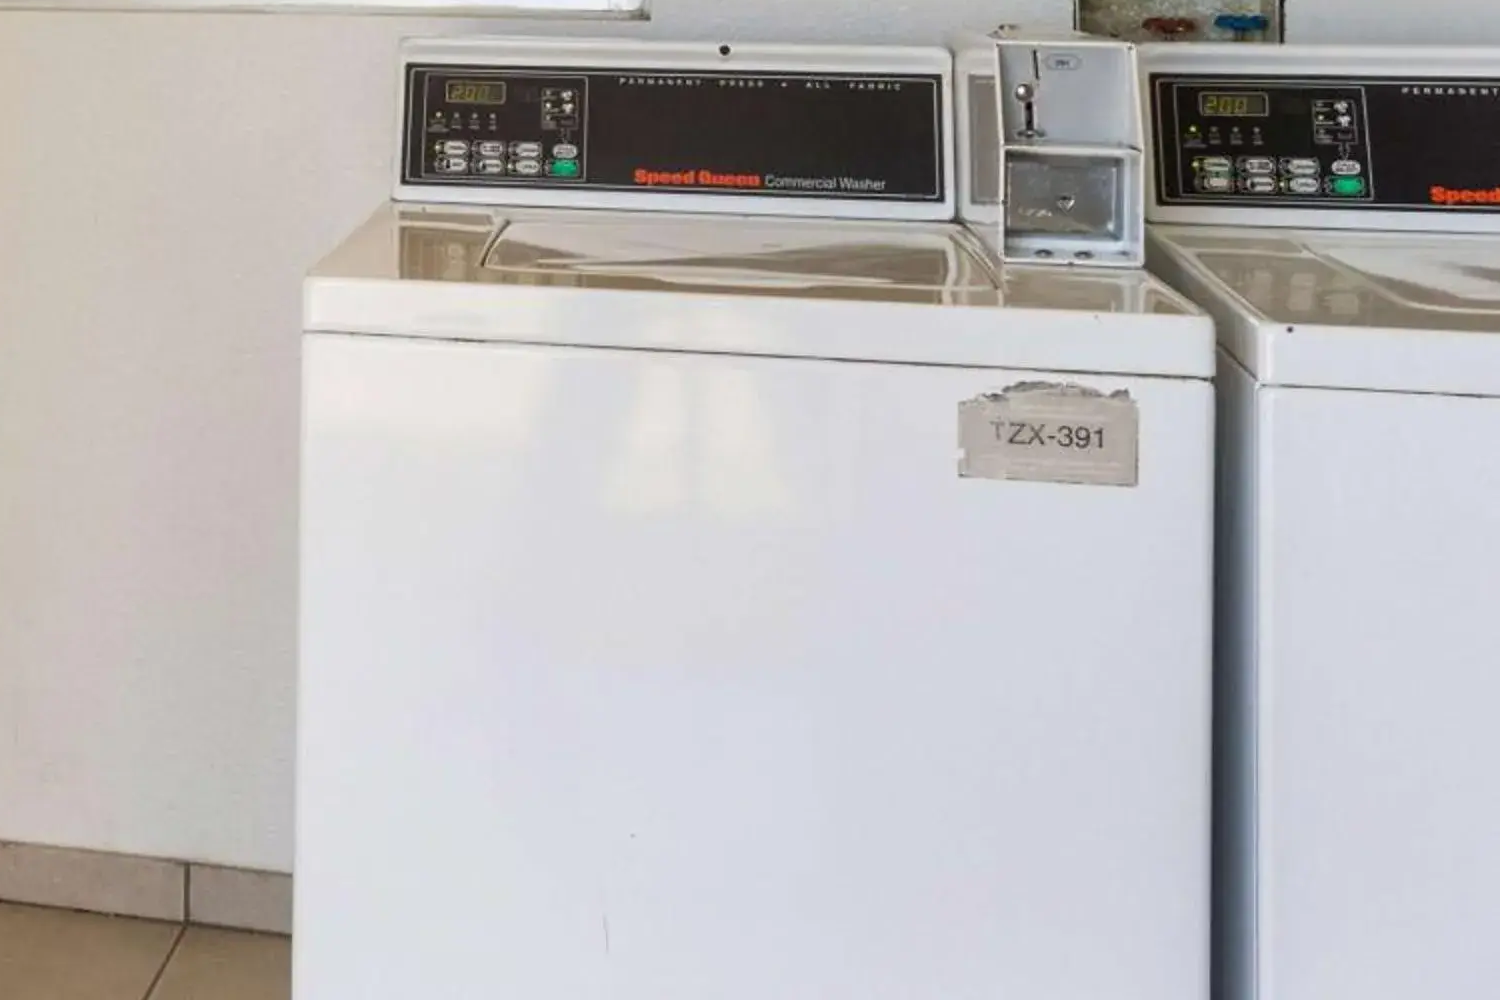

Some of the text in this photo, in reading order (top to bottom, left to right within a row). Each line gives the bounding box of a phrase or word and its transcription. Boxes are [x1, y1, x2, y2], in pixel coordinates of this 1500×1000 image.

[451, 85, 490, 101] 200
[1203, 96, 1248, 113] 200
[634, 168, 887, 191] Speed Queen Commercial Washer
[989, 419, 1105, 449] TZX-391
